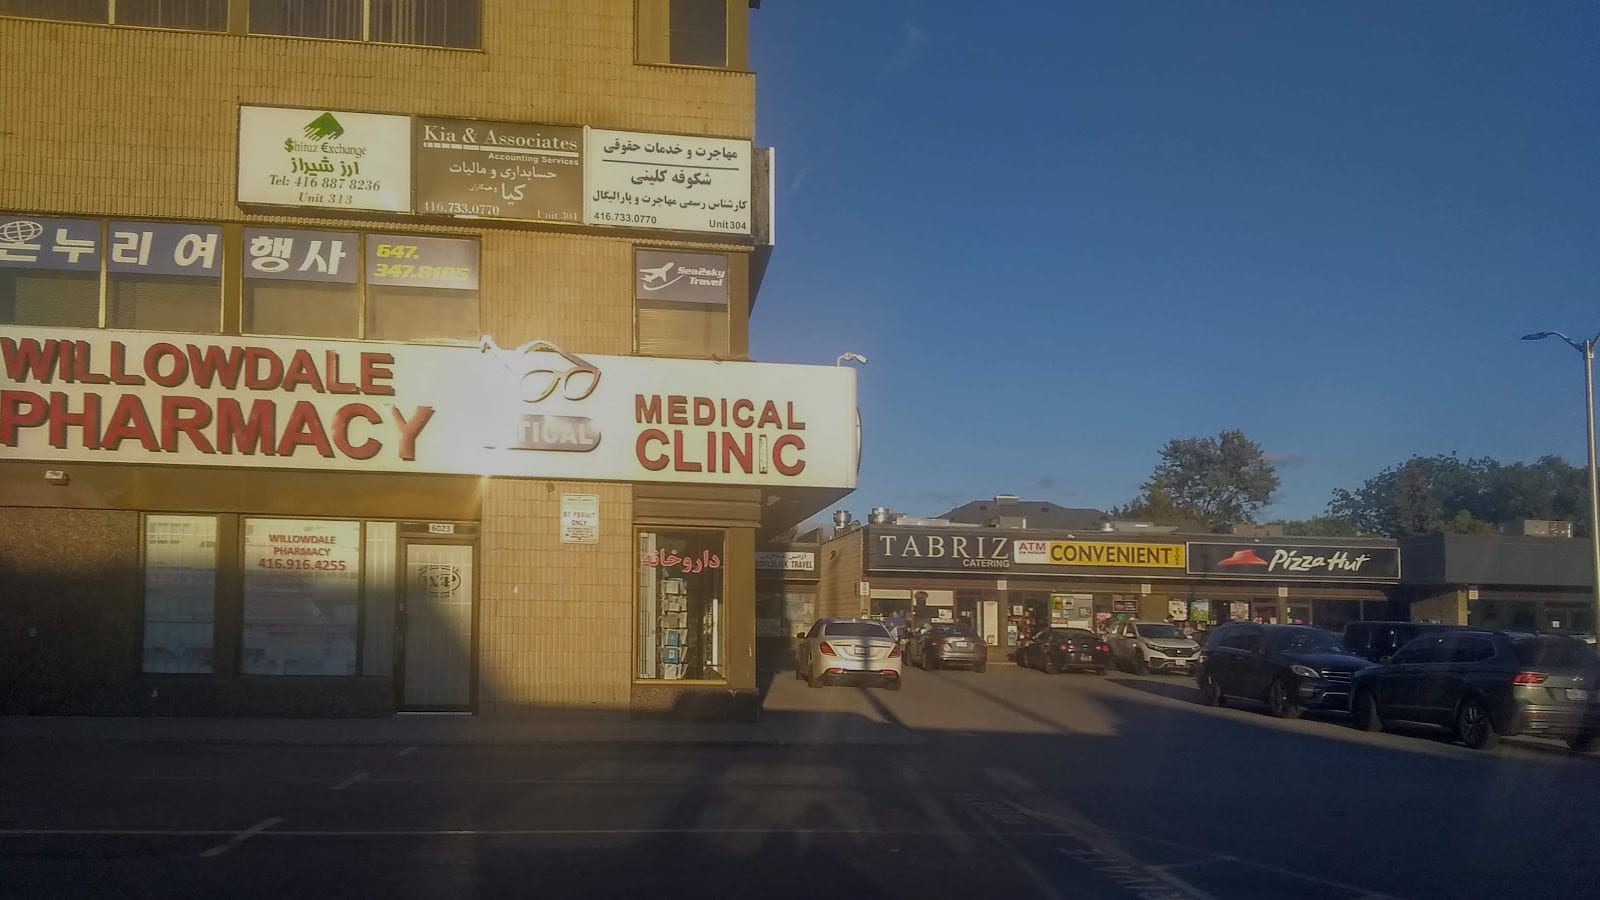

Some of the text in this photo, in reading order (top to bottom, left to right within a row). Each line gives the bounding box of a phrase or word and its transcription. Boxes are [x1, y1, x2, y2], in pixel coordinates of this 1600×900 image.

[424, 125, 578, 150] Kia & Associates
[604, 139, 738, 161] مهاجرت و خدمات حقوقی
[291, 156, 359, 177] ارز شیراز
[488, 152, 579, 166] Accounting Services
[449, 162, 557, 181] حسابداری و مالیات
[631, 168, 712, 188] شکوفه کلینی
[270, 174, 380, 192] Tel: 416 887 8236
[298, 192, 352, 205] Unit 313
[501, 182, 526, 205] کیا
[634, 196, 640, 206] و
[642, 194, 676, 207] مهاجرت
[680, 198, 706, 210] رسمی
[708, 198, 747, 212] کارشناس
[594, 212, 657, 224] 416.733.0770
[376, 244, 419, 260] 647.
[676, 266, 726, 278] Sea2sky
[689, 276, 723, 286] Travel
[0, 336, 396, 396] WILLOWDALE
[634, 394, 806, 430] MEDICAL
[0, 390, 435, 462] PHARMACY
[634, 429, 806, 477] CLINIC
[269, 534, 336, 544] WILLOWDALE
[880, 535, 1009, 559] TABRIZ
[1019, 542, 1046, 551] ATM
[274, 548, 331, 556] PHARMACY
[1050, 545, 1172, 564] CONVENIENT
[258, 558, 346, 572] 416.916.4255
[642, 548, 720, 573] داروخانه
[791, 560, 813, 569] TRAVEL
[962, 558, 1010, 568] CATERING
[1268, 550, 1370, 572] Pizza Hut
